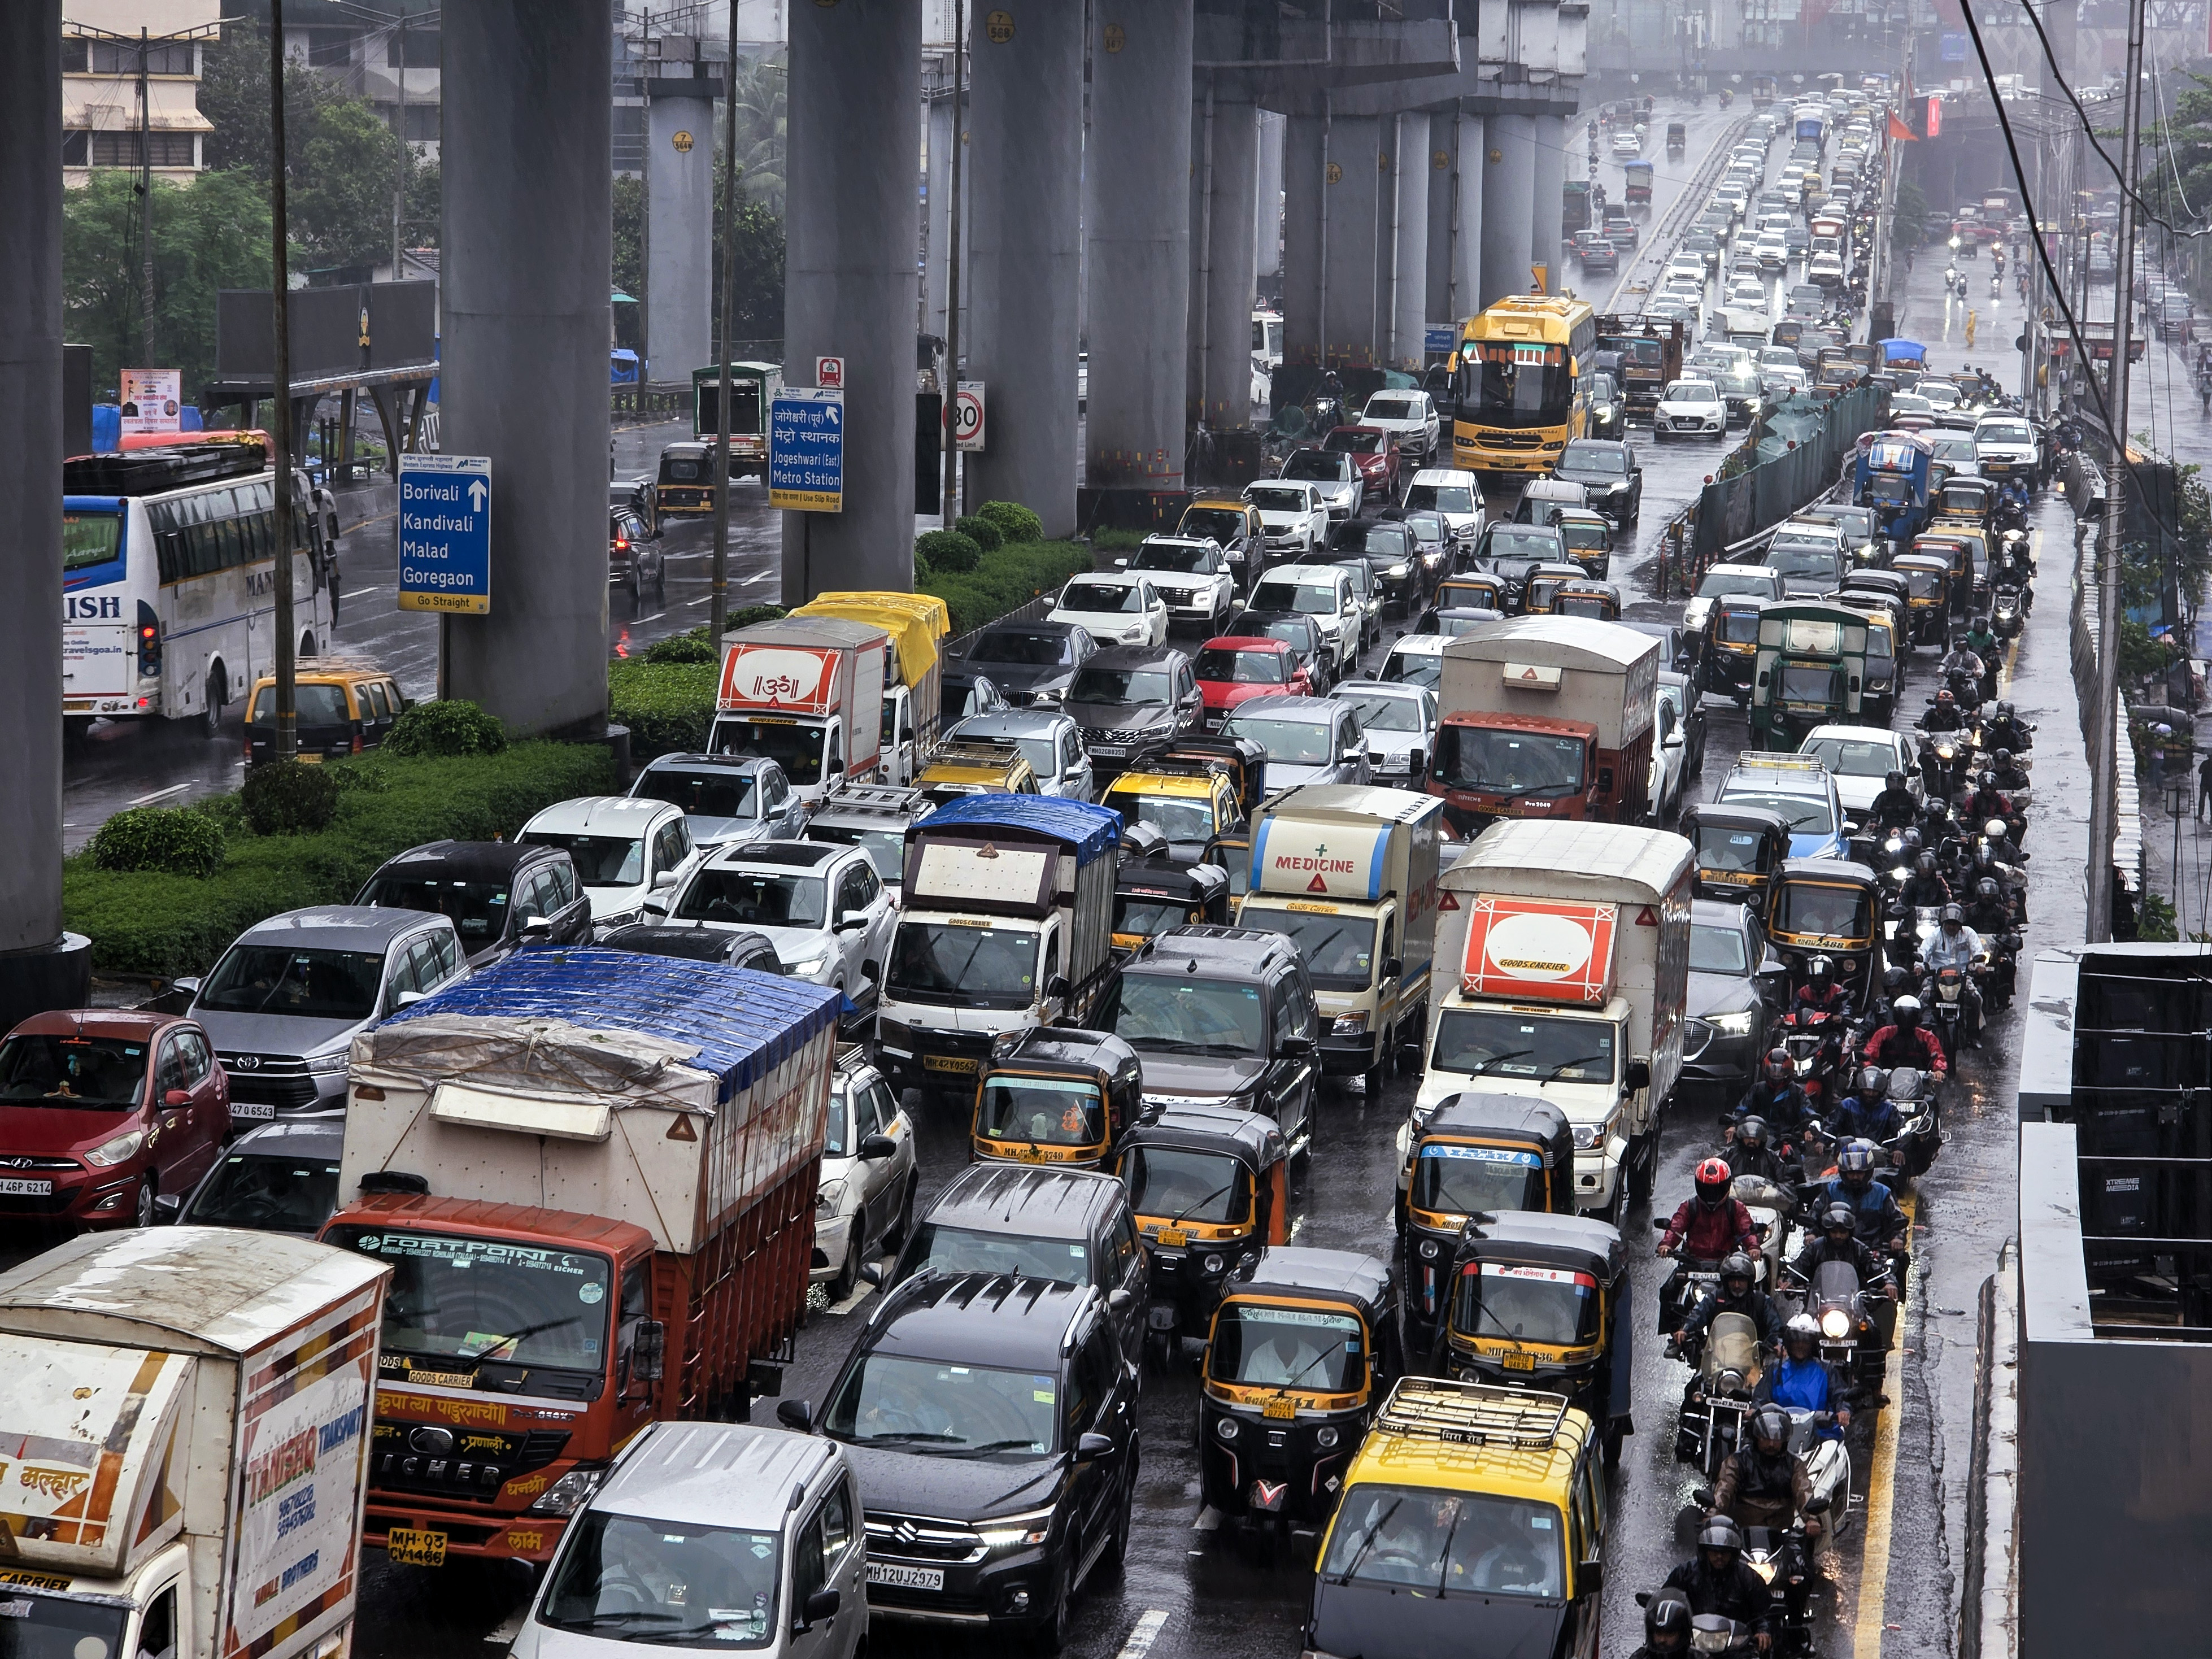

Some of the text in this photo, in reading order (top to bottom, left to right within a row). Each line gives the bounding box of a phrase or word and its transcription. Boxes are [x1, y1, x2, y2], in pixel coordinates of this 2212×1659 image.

[774, 408, 807, 423] जोगेश्वरी
[774, 427, 840, 444] मेट्रो स्थानक
[774, 450, 839, 468] Jogeshwari (East)
[773, 470, 839, 486] Metro Station
[403, 483, 459, 501] Borivali
[403, 513, 473, 532] Kandivali
[403, 541, 448, 559] Malad
[403, 567, 473, 588] Goregaon
[64, 596, 121, 619] ISH
[417, 595, 469, 608] Go Straight
[63, 646, 122, 655] ravelsgoa.in
[1275, 856, 1354, 873] MEDICINE
[232, 1105, 241, 1114] 47
[251, 1107, 273, 1117] 6543
[1044, 1151, 1064, 1160] 5749
[6, 1183, 50, 1194] 46P 6214
[554, 1265, 584, 1275] EICHER
[410, 1371, 471, 1386] GOODS CARRIER
[1268, 1403, 1291, 1411] MH47A
[1268, 1409, 1290, 1418] D7741
[1442, 1430, 1483, 1444] मिरा रोड
[381, 1454, 499, 1486] ICHER
[20, 1466, 90, 1501] मल्हार
[0, 1572, 72, 1591] CARRIER
[866, 1565, 940, 1587] MH12UJ2979
